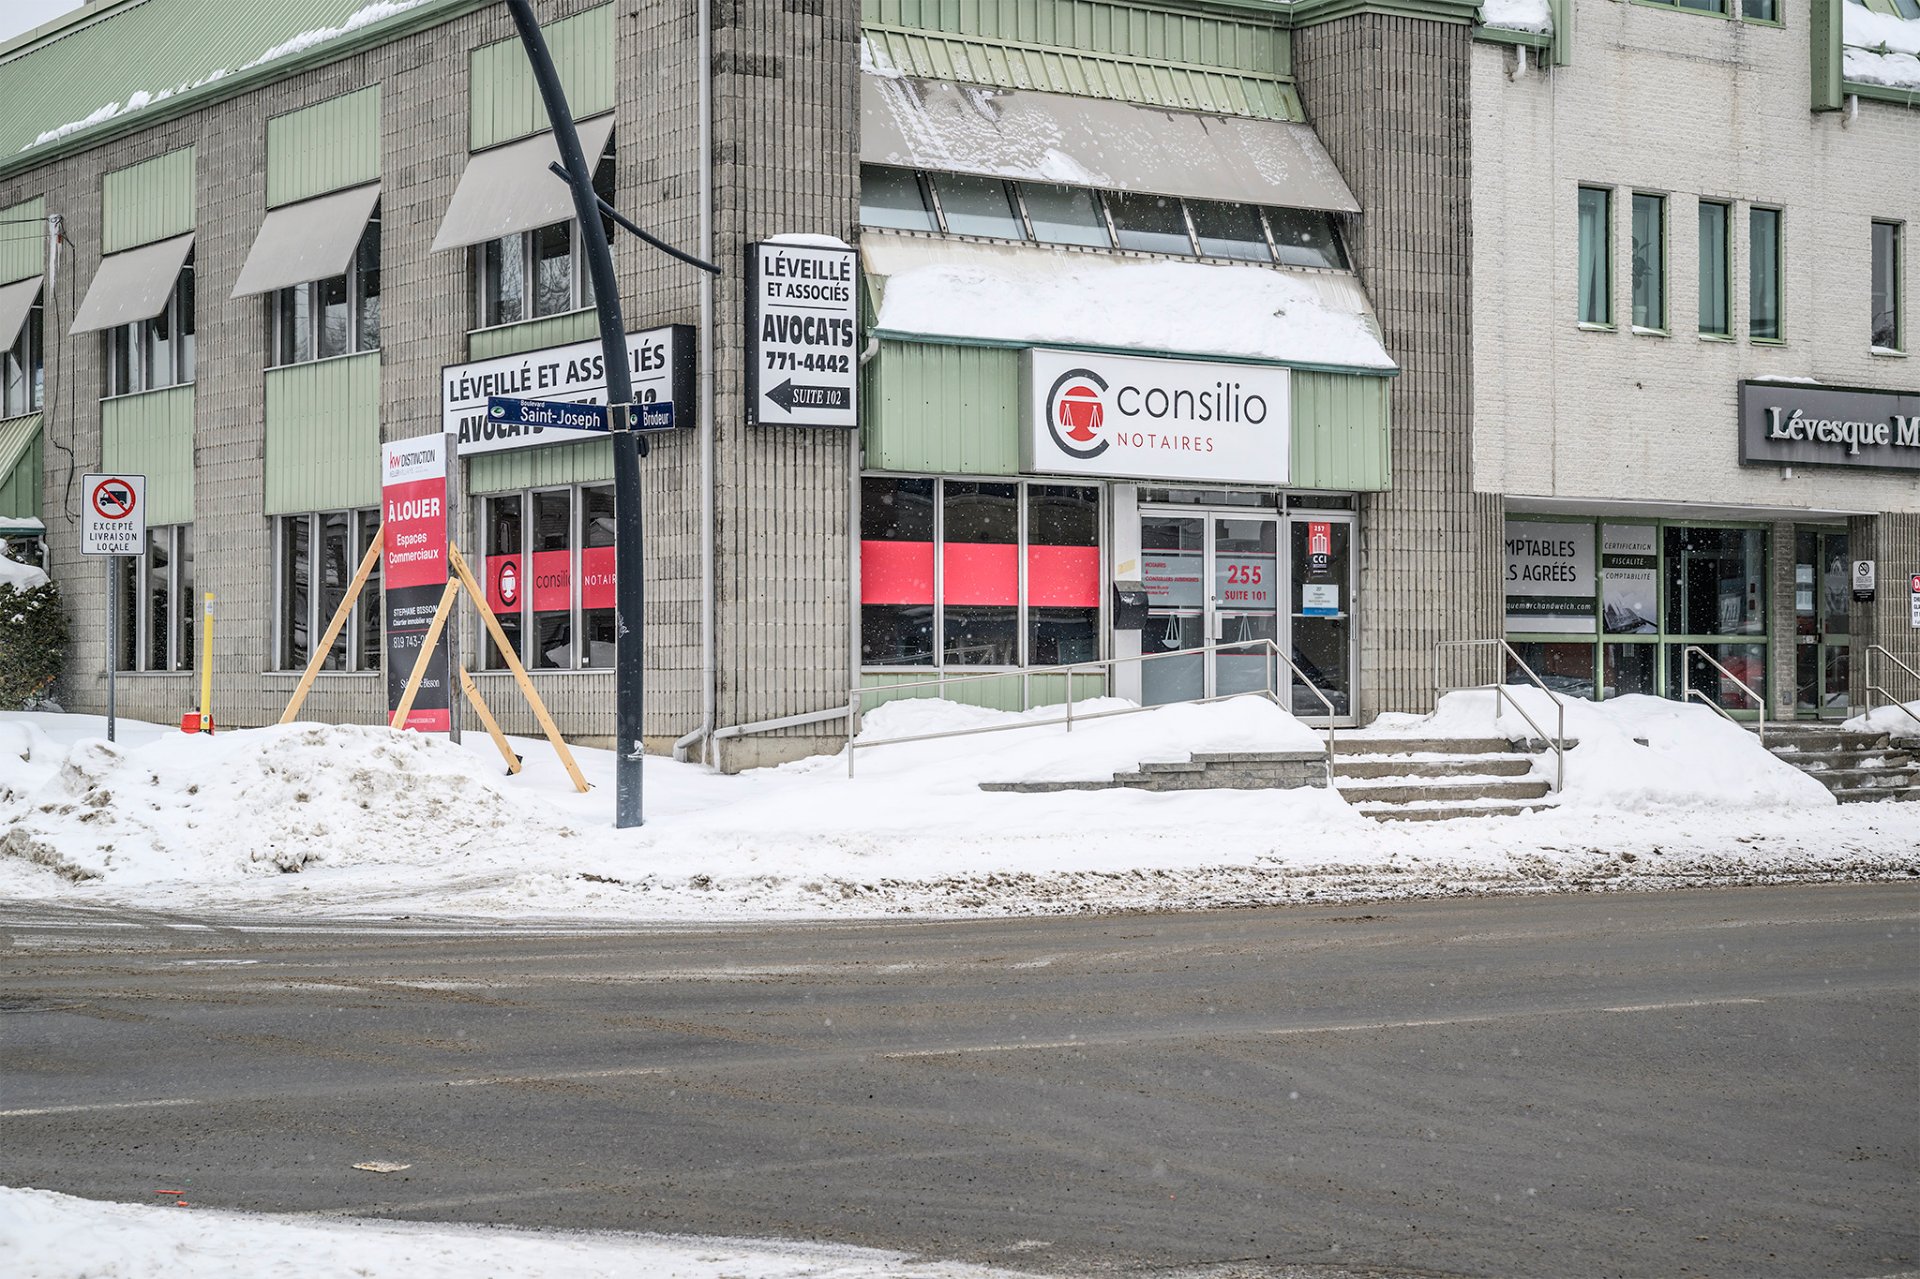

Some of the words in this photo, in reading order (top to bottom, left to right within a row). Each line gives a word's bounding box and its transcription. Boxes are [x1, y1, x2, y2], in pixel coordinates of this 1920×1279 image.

[765, 250, 851, 281] LÉVEILLÉ
[767, 282, 782, 297] ET
[786, 282, 849, 301] ASSOCIÉS
[762, 314, 853, 347] AVOCATS
[450, 360, 532, 402] LÉVEILLÉ
[538, 363, 559, 389] ET
[565, 338, 665, 384] ASSIÉS
[766, 351, 849, 373] 771-4442
[520, 400, 545, 408] Boulevard
[793, 389, 823, 405] SUITE
[826, 390, 841, 405] 102
[1117, 381, 1267, 424] consilio
[520, 407, 600, 429] Saint-Joseph
[644, 410, 669, 426] Brodeur
[1768, 406, 1889, 455] Lévesque
[1117, 432, 1214, 452] NOTAIRES
[401, 449, 435, 467] DISTINCTION
[388, 500, 396, 523] À
[397, 497, 440, 521] LOUER
[93, 521, 133, 530] EXCEPTÉ
[89, 532, 137, 541] LIVRAISON
[396, 532, 427, 548] Espaces
[97, 543, 129, 551] LOCALE
[1604, 542, 1651, 551] CERTIFICATION
[389, 548, 439, 564] Commerciaux
[1313, 555, 1327, 564] CCI
[1227, 564, 1262, 585] 255
[1522, 561, 1577, 582] AGRÉÉS
[1225, 590, 1248, 600] SUITE
[1252, 591, 1267, 600] 101
[393, 606, 416, 616] STEPHANE
[393, 636, 404, 648] 819
